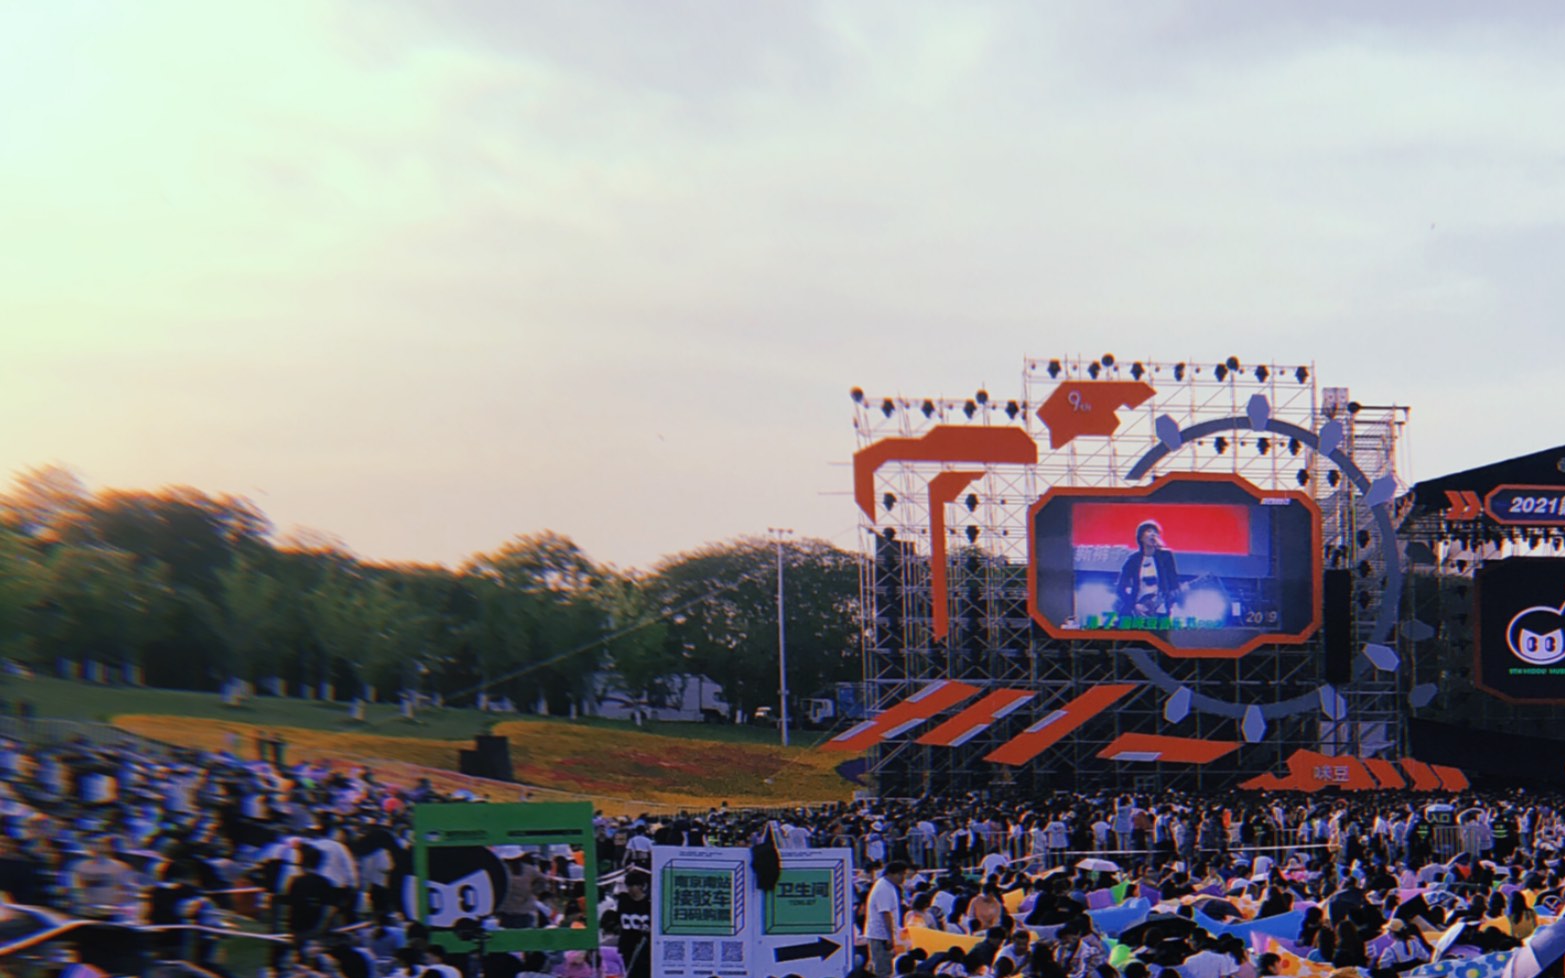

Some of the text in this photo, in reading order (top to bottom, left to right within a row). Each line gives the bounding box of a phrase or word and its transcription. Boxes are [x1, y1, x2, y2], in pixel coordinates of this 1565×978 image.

[674, 889, 731, 908] 接驳车
[776, 881, 830, 899] 卫生间
